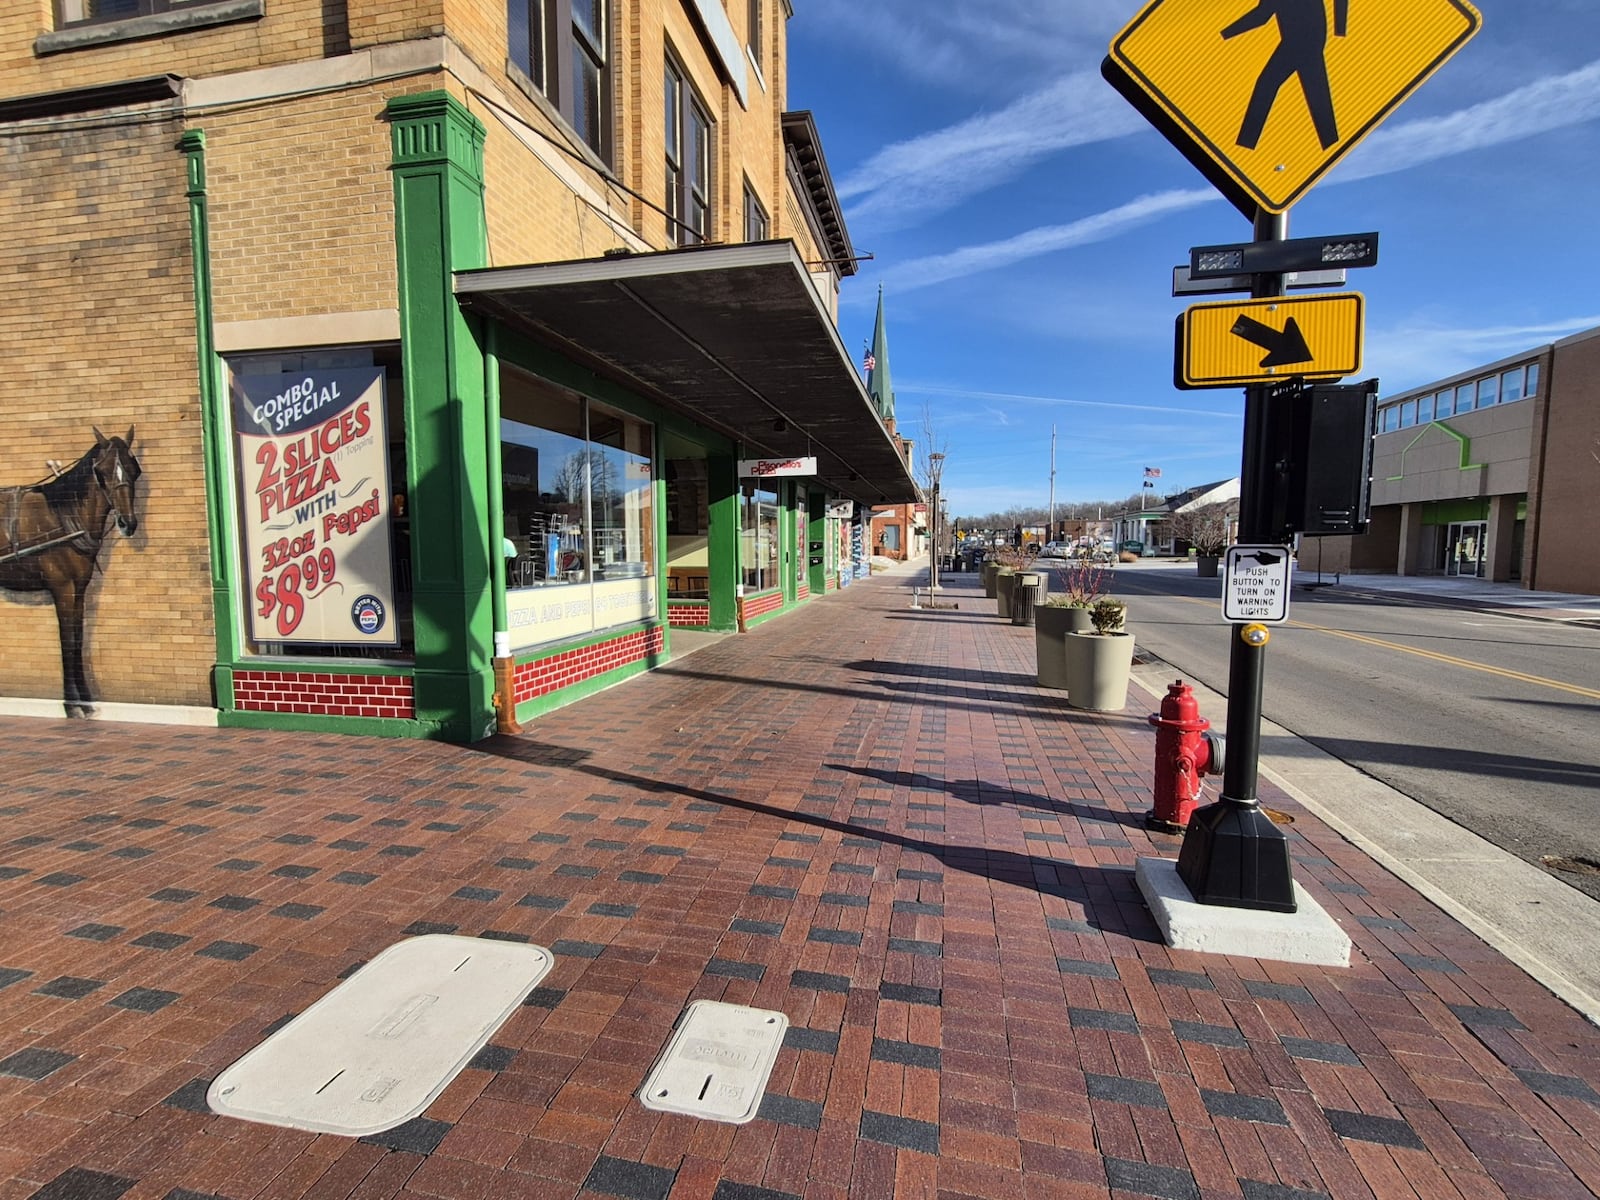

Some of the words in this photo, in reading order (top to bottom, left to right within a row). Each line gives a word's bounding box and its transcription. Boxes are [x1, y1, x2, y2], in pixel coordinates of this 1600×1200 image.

[253, 377, 314, 424] COMBO
[276, 381, 341, 432] SPECIAL
[256, 441, 281, 493] 2
[282, 402, 371, 477] SLICES
[345, 435, 374, 456] Topping
[259, 456, 341, 523] PIZZA
[295, 489, 337, 524] WITH
[262, 529, 316, 572] 32oz
[322, 488, 380, 543] Pepsi
[1233, 578, 1264, 586] BUTTON
[1271, 578, 1281, 586] TO
[1246, 568, 1268, 576] PUSH
[1237, 588, 1258, 596] TURN
[1264, 588, 1276, 596] ON
[1237, 598, 1274, 606] WARNING
[541, 603, 562, 623] AND
